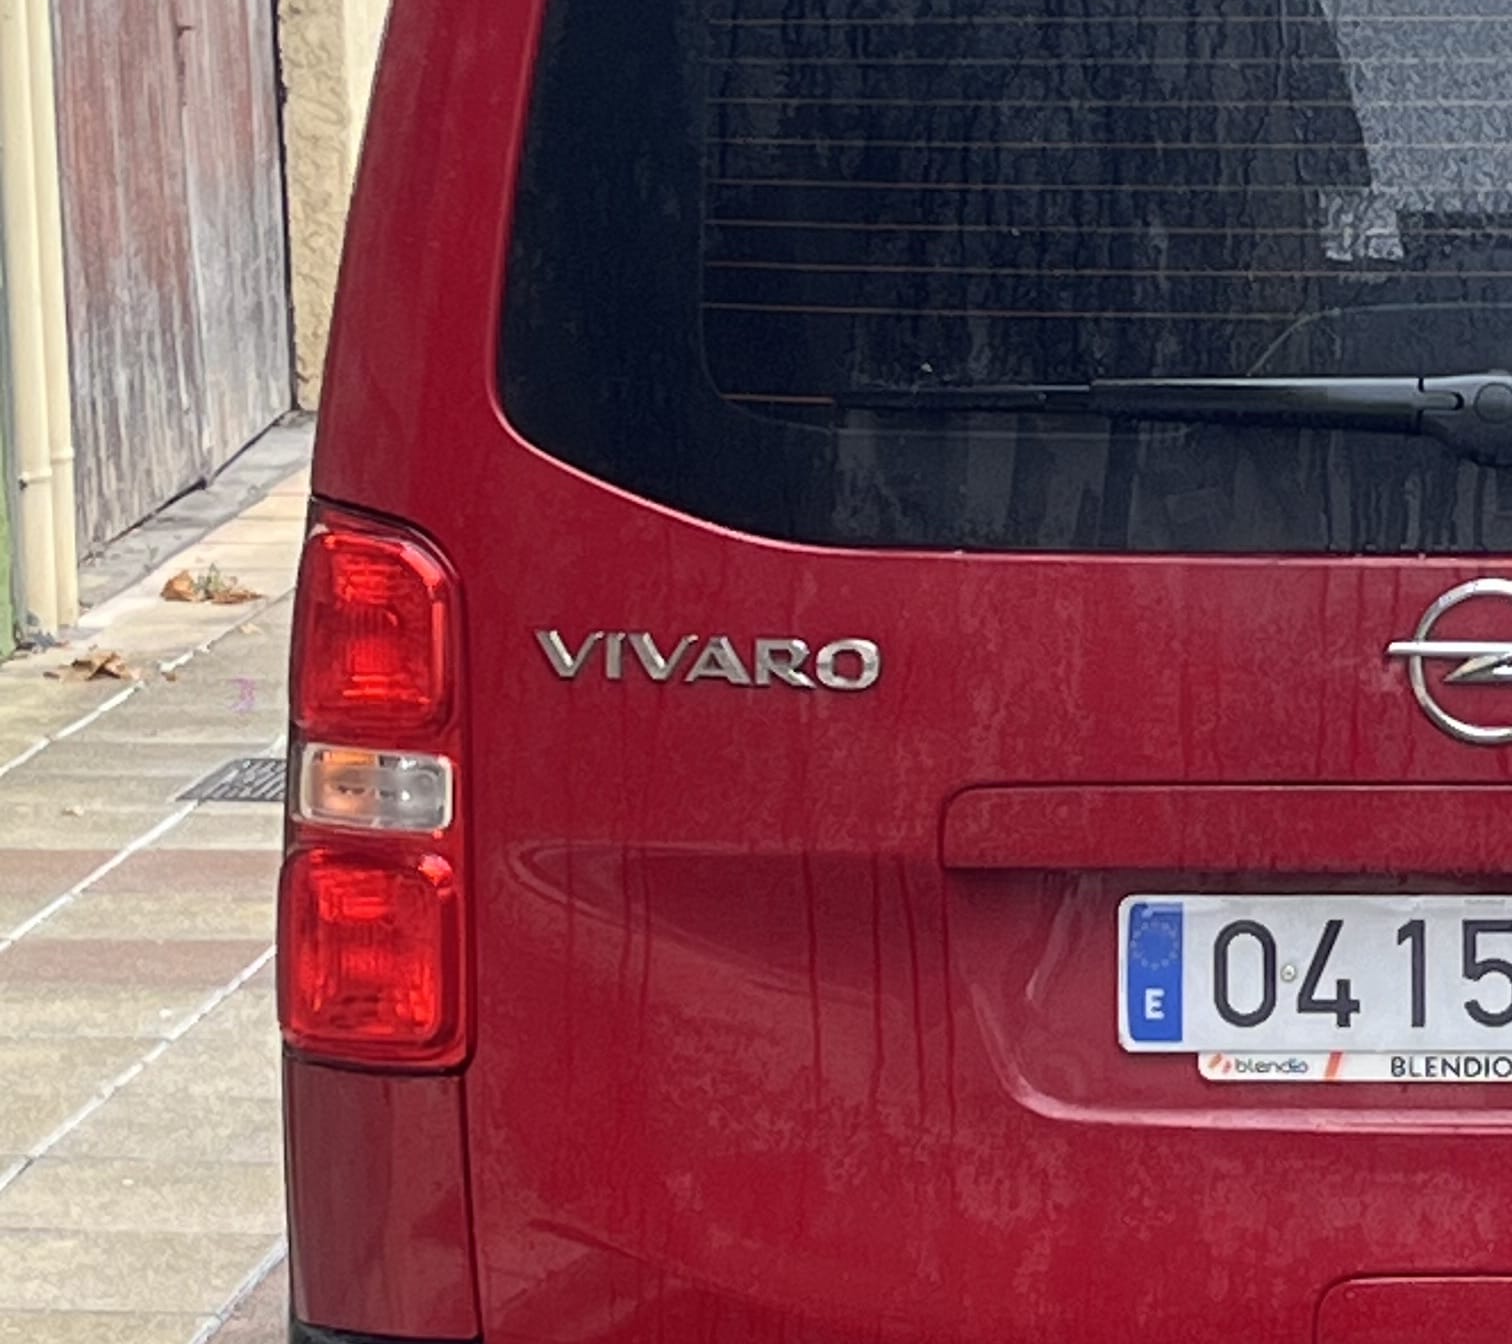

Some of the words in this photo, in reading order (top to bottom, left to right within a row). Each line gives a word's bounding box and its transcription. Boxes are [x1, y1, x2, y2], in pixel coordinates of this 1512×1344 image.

[535, 630, 882, 691] VIVARO
[1145, 988, 1165, 1020] E
[1234, 1058, 1309, 1074] blendio
